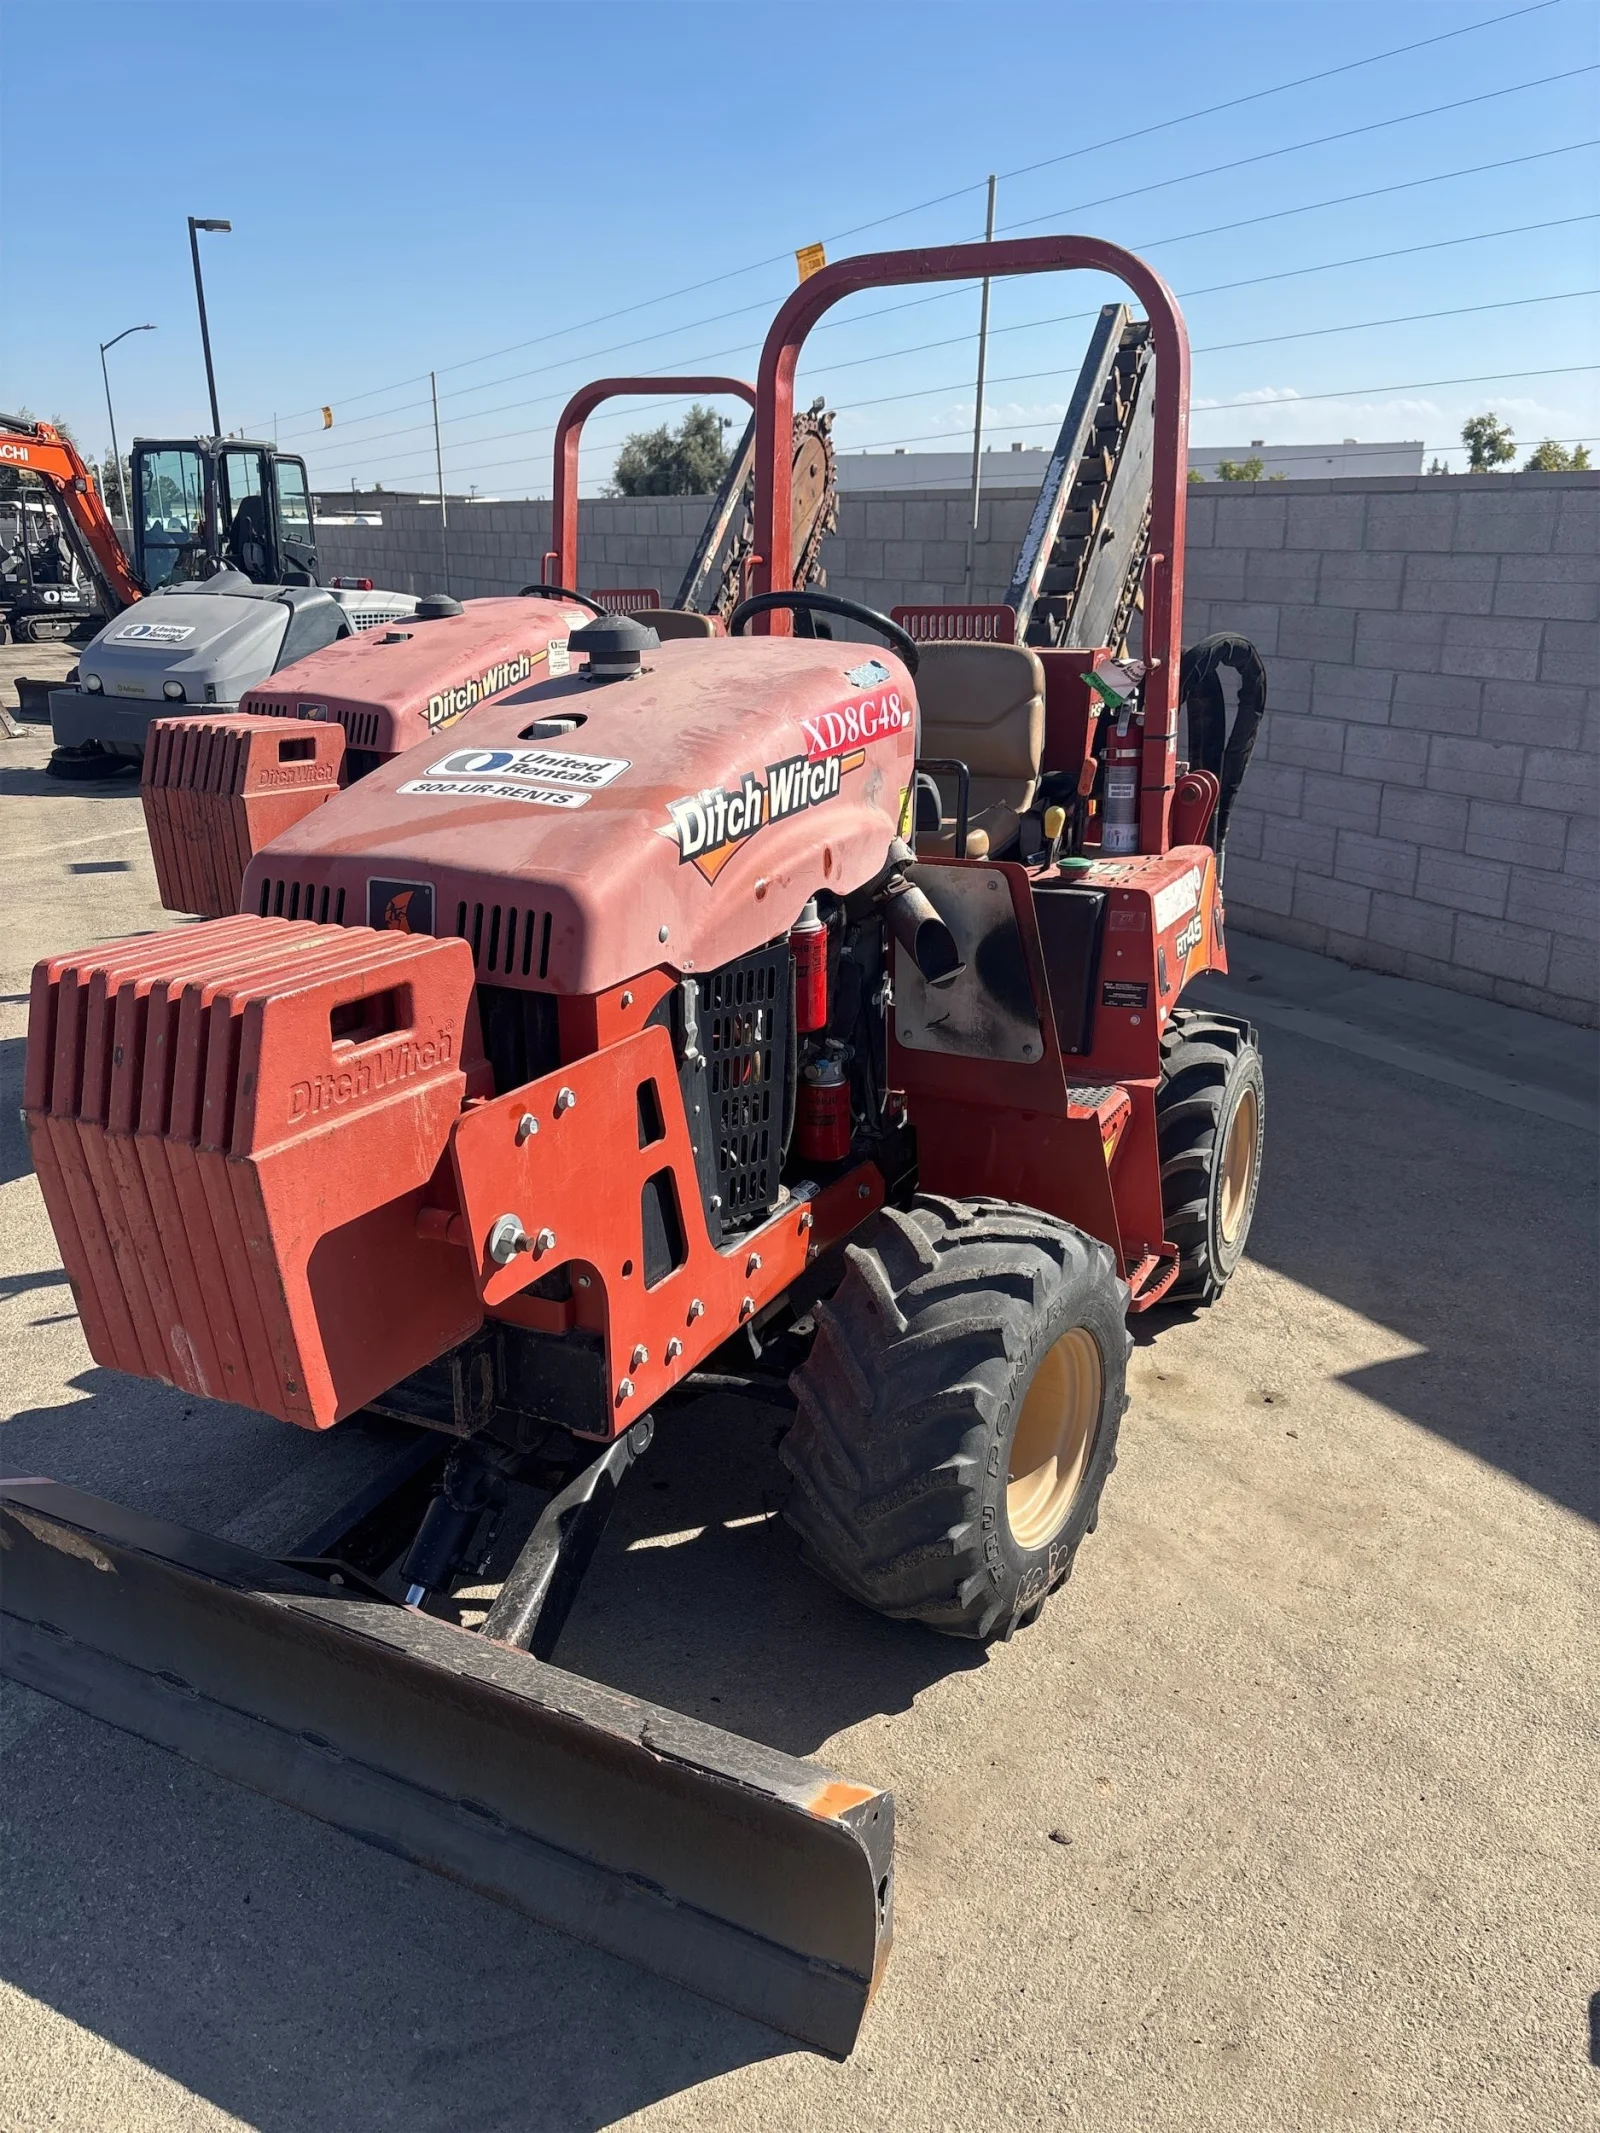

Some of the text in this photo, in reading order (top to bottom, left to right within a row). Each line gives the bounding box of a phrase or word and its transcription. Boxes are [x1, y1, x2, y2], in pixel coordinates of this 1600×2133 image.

[152, 626, 188, 634] United
[429, 680, 478, 724] Ditch
[482, 654, 530, 696] Witch
[800, 693, 901, 756] XD8G48
[258, 762, 333, 788] Ditch Witch
[502, 763, 603, 785] Rentals
[518, 753, 611, 772] United
[412, 783, 574, 804] 800-UR-RENTS
[676, 779, 763, 858] Ditch
[769, 755, 840, 818] Witch
[1176, 914, 1202, 958] RT45
[287, 1029, 452, 1124] Ditch Witch
[982, 1505, 1007, 1585] TRU
